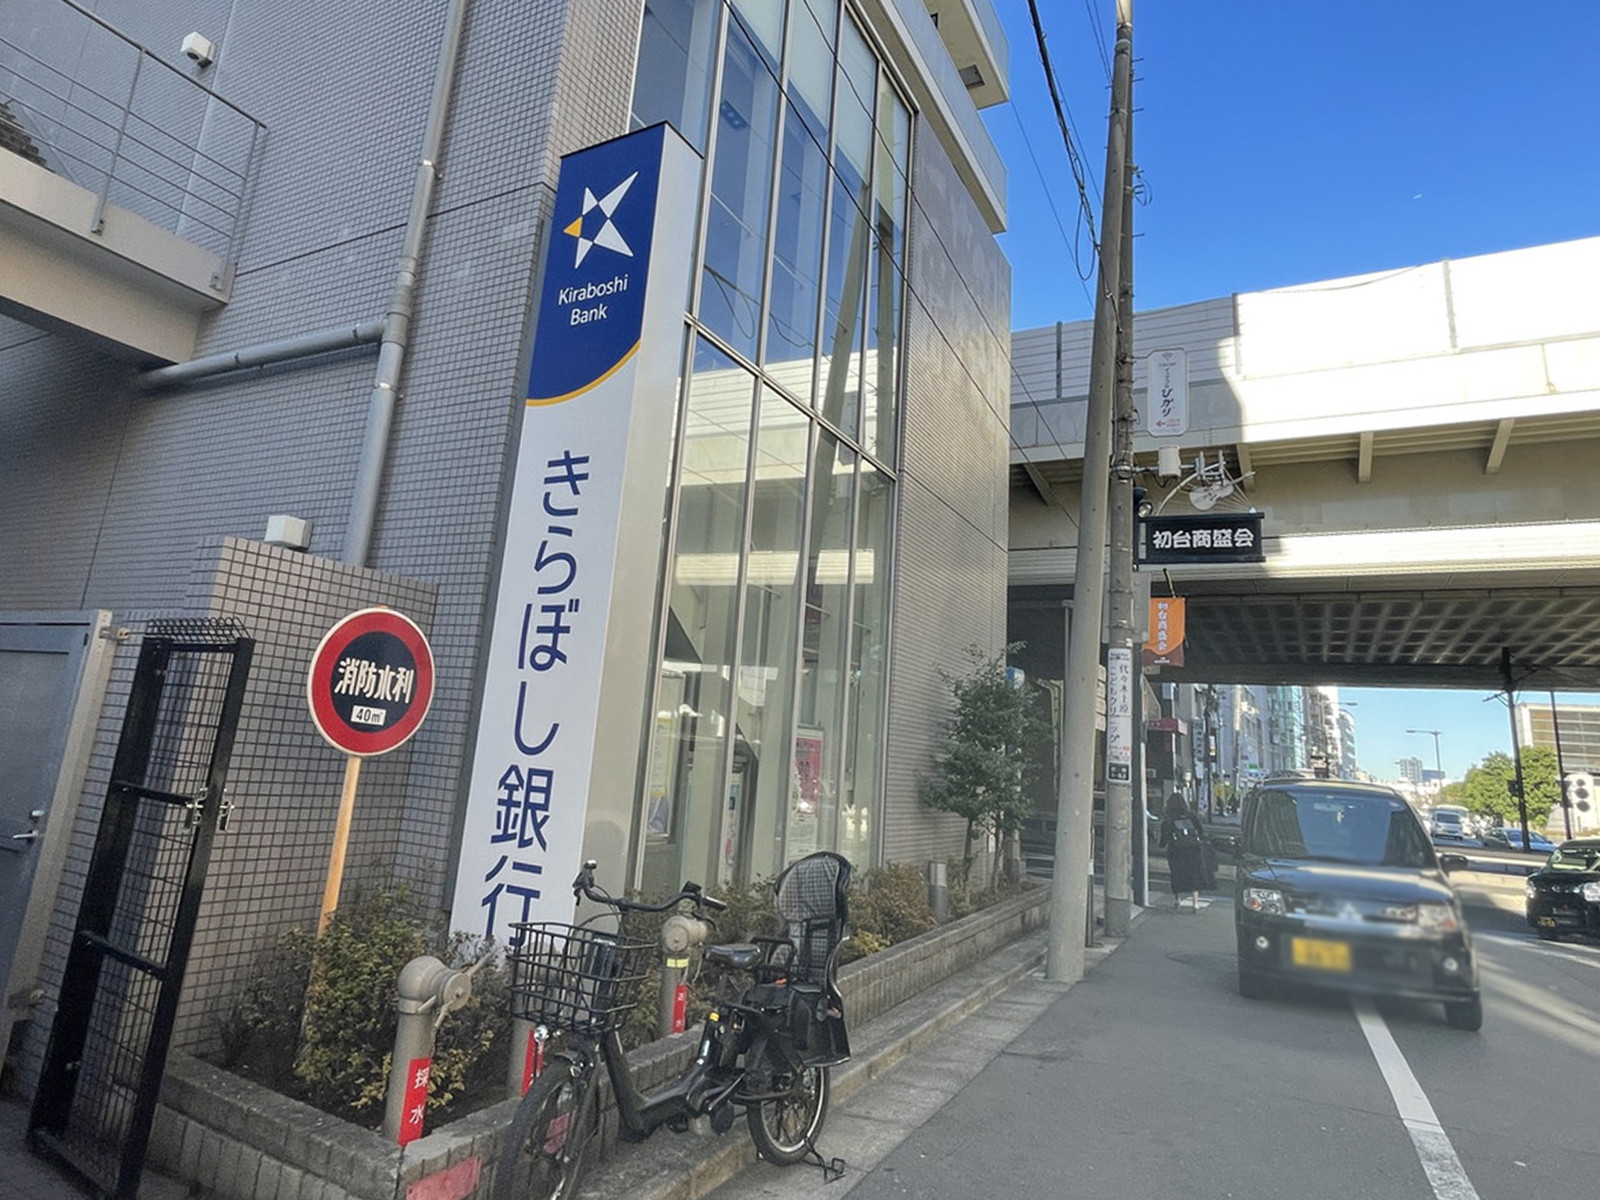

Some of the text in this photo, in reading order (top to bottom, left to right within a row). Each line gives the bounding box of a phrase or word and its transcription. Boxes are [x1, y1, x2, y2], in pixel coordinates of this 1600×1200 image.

[558, 274, 628, 305] Kiraboshi
[570, 304, 607, 325] Bank
[1152, 528, 1254, 549] 初台商盛会
[334, 657, 414, 704] 消防水利
[481, 450, 590, 947] きらぼし銀行
